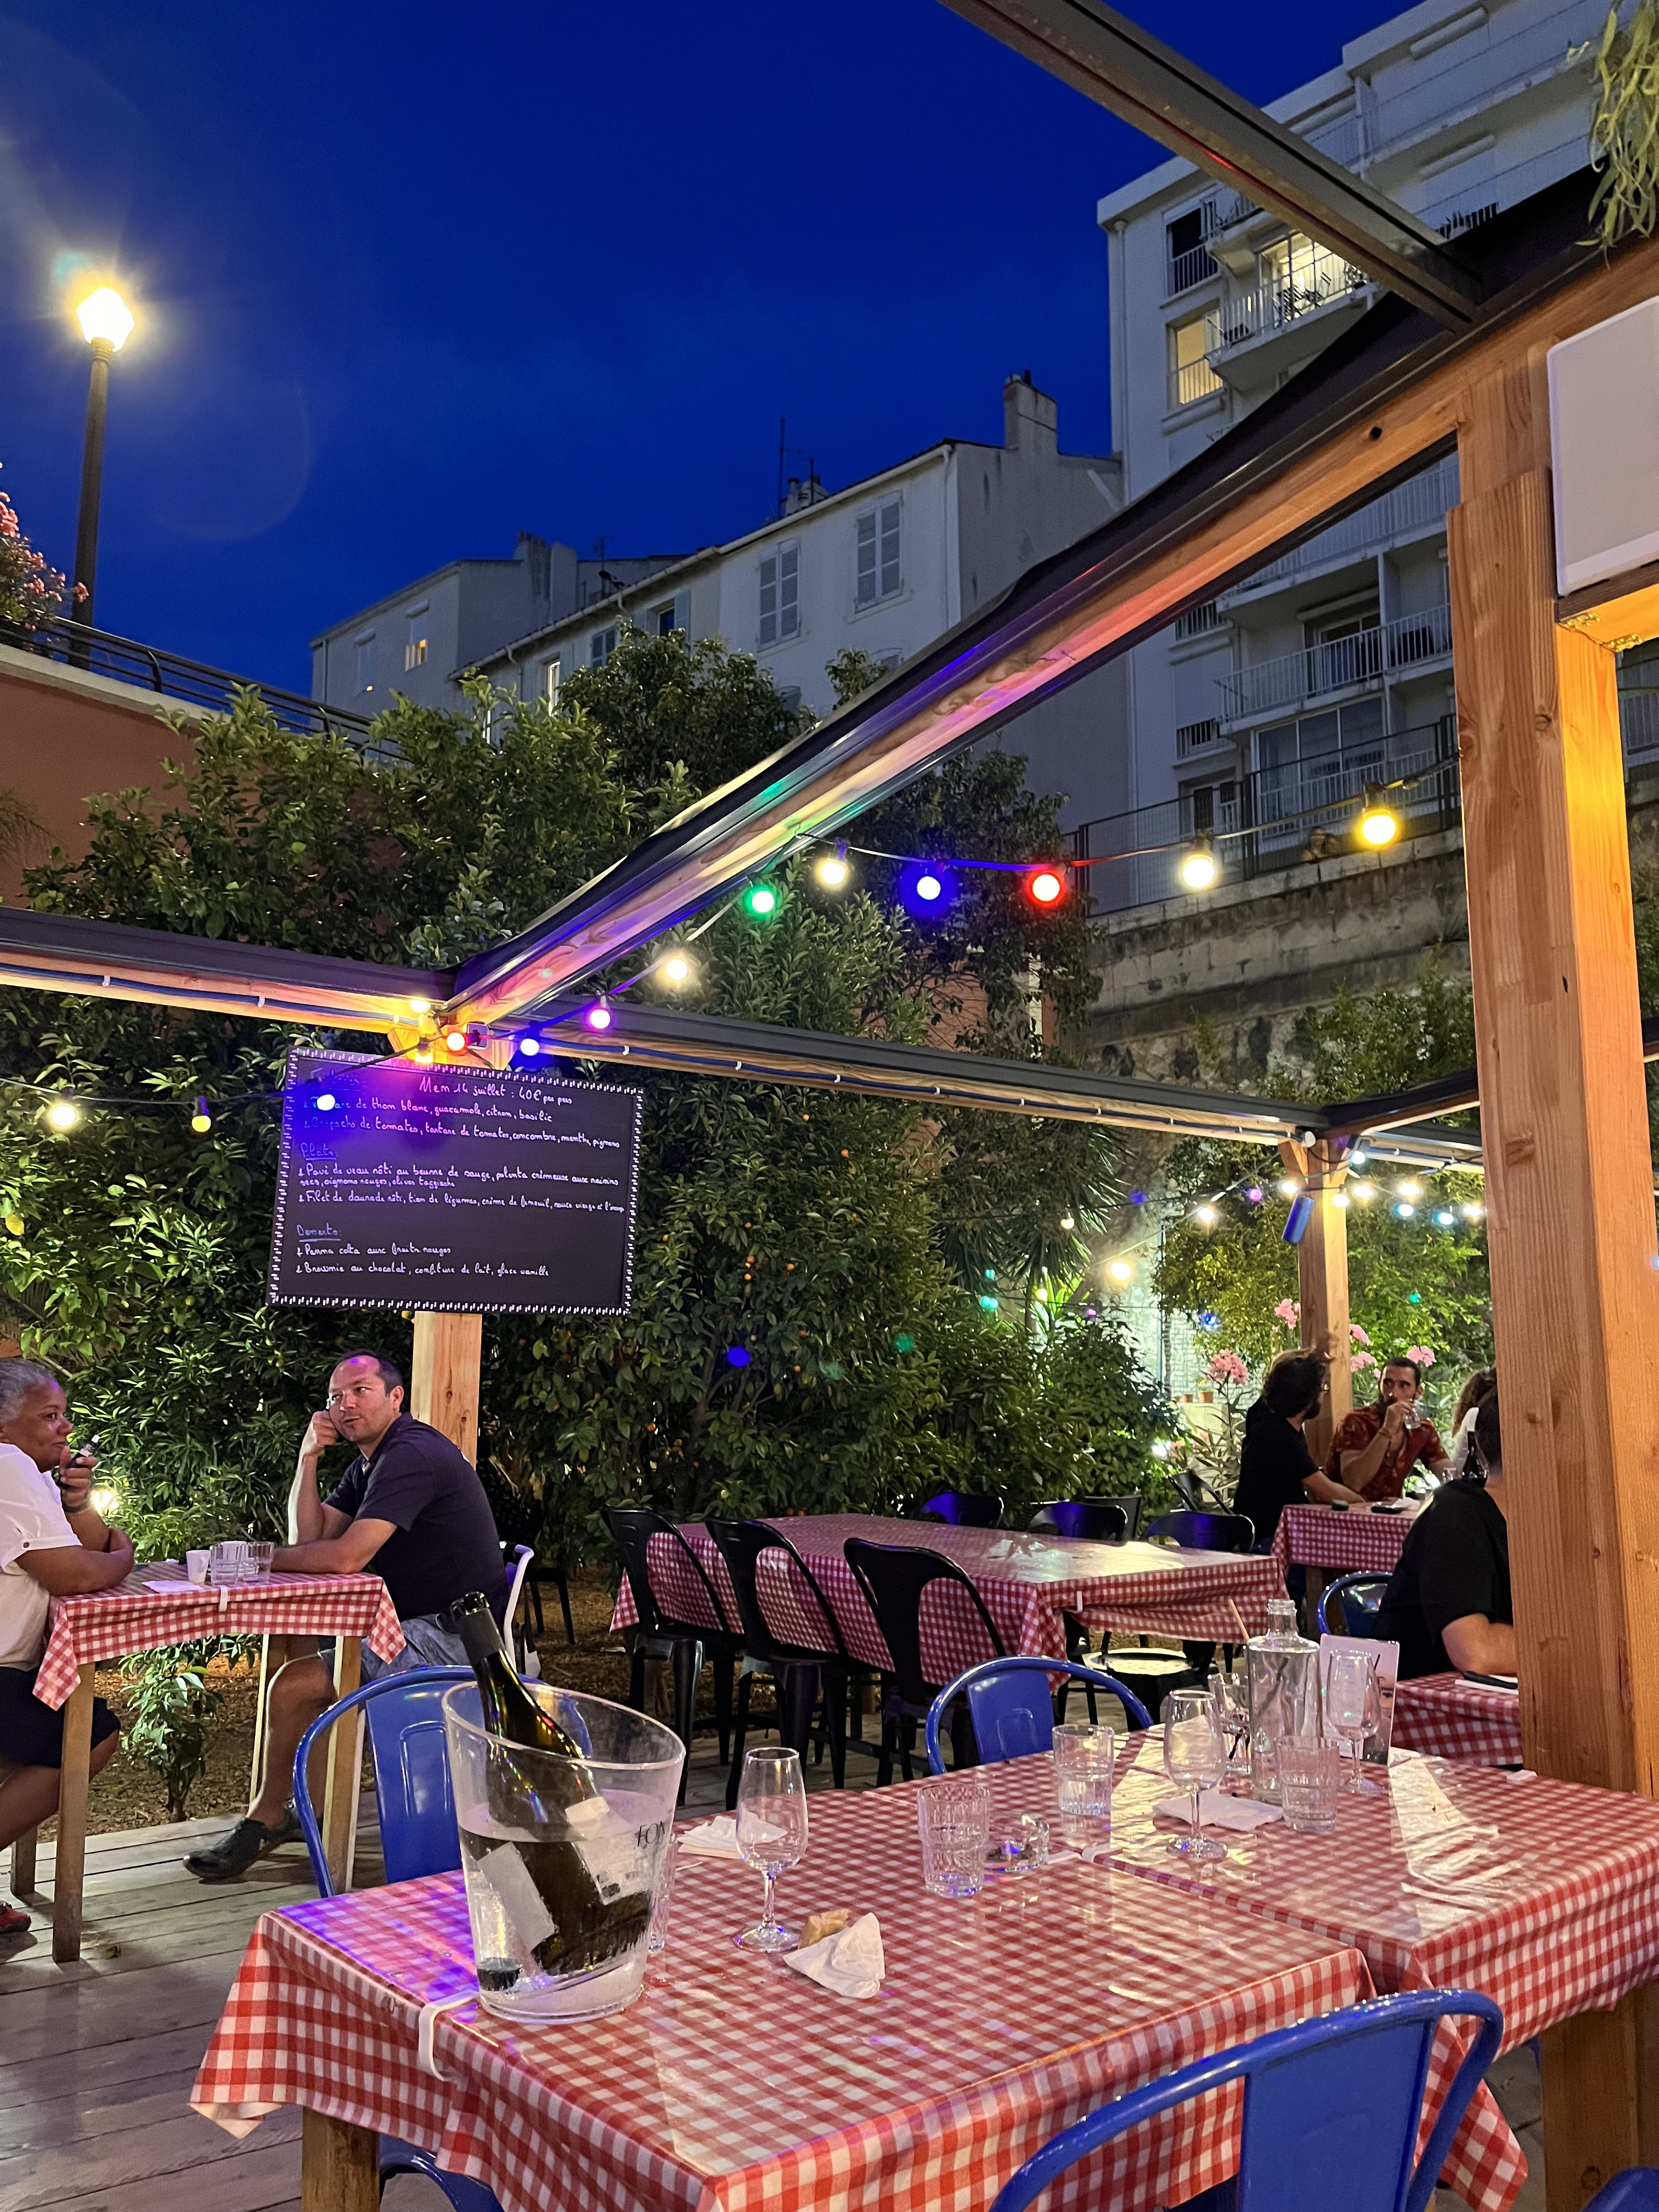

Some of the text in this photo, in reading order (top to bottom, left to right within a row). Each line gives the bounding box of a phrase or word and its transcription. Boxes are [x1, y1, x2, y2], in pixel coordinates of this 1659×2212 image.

[472, 1083, 506, 1097] juillet
[518, 1086, 542, 1101] 40€
[356, 1098, 367, 1109] de
[372, 1097, 396, 1110] thon
[519, 1109, 552, 1122] basilic
[360, 1116, 371, 1129] de
[425, 1121, 456, 1135] tartare
[460, 1124, 470, 1136] de
[306, 1163, 329, 1176] Pavé
[332, 1163, 343, 1175] de
[373, 1162, 393, 1175] rôti
[413, 1164, 443, 1176] beurre
[447, 1165, 459, 1177] de
[392, 1175, 415, 1186] olives
[306, 1189, 330, 1202] Filet
[332, 1190, 343, 1202] de
[348, 1189, 385, 1202] daurade
[428, 1193, 438, 1203] de
[509, 1195, 517, 1205] de
[304, 1243, 334, 1256] Panna
[422, 1247, 451, 1257] rouges
[304, 1261, 345, 1273] Brownie
[415, 1262, 455, 1276] confiture
[461, 1263, 470, 1274] de
[497, 1262, 517, 1277] glace
[520, 1265, 549, 1276] vanille
